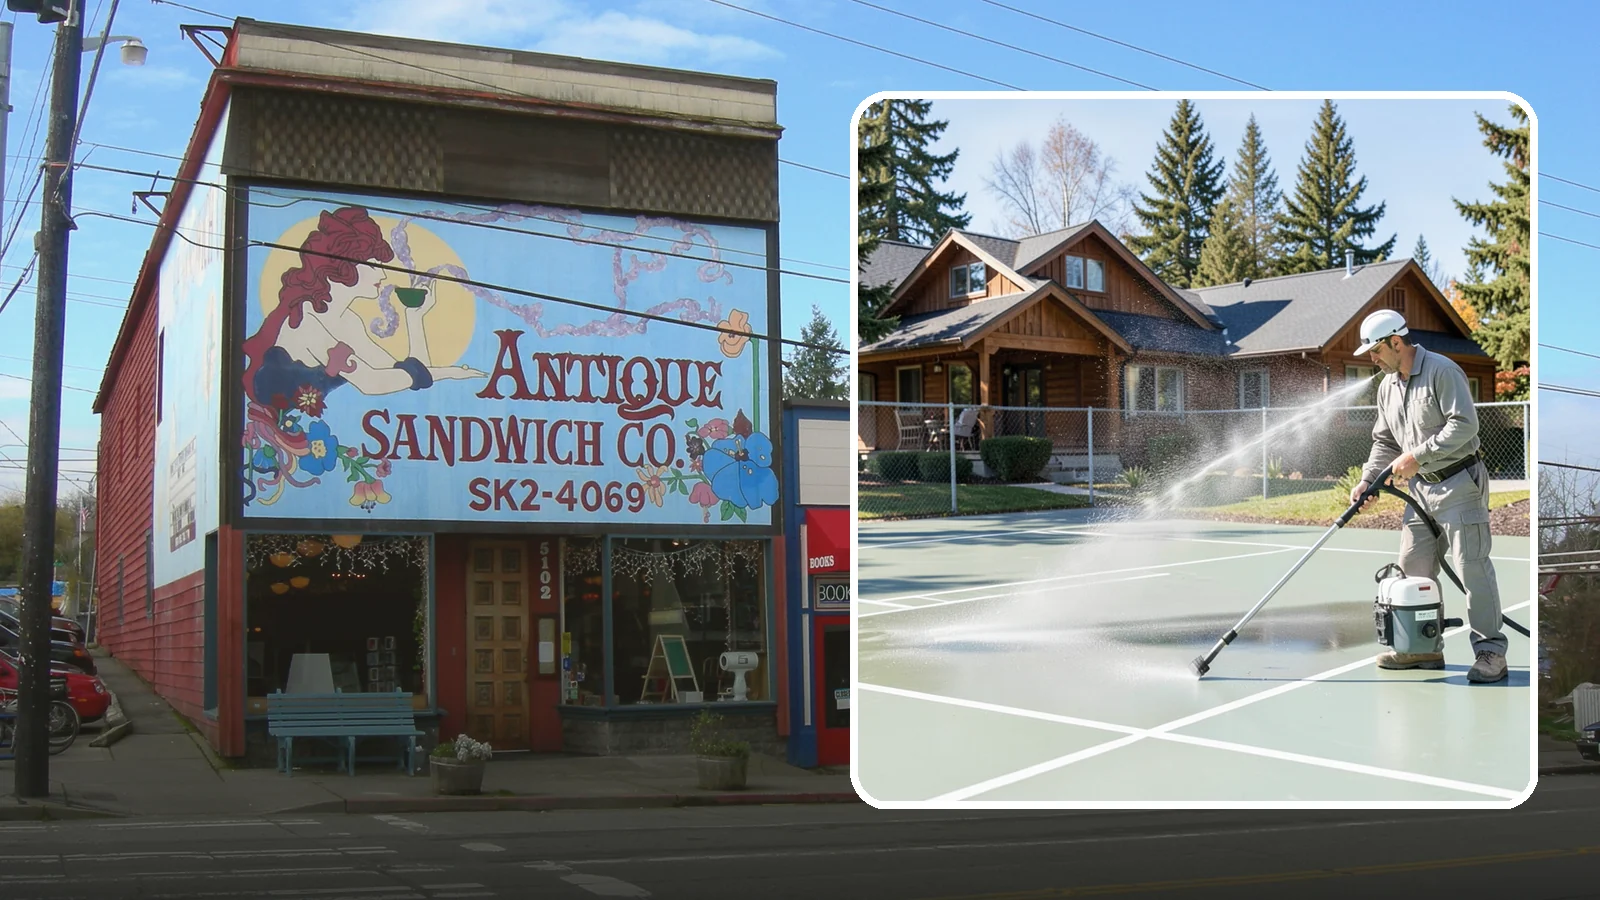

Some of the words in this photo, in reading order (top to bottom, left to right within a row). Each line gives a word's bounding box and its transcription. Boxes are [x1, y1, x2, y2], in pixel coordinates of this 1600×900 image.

[476, 329, 724, 421] ANTIQUE
[361, 409, 604, 468] SANDWICH
[617, 422, 685, 469] CO.
[468, 477, 645, 513] SK2-4069
[539, 542, 552, 600] 5102
[809, 555, 835, 569] BOOKS
